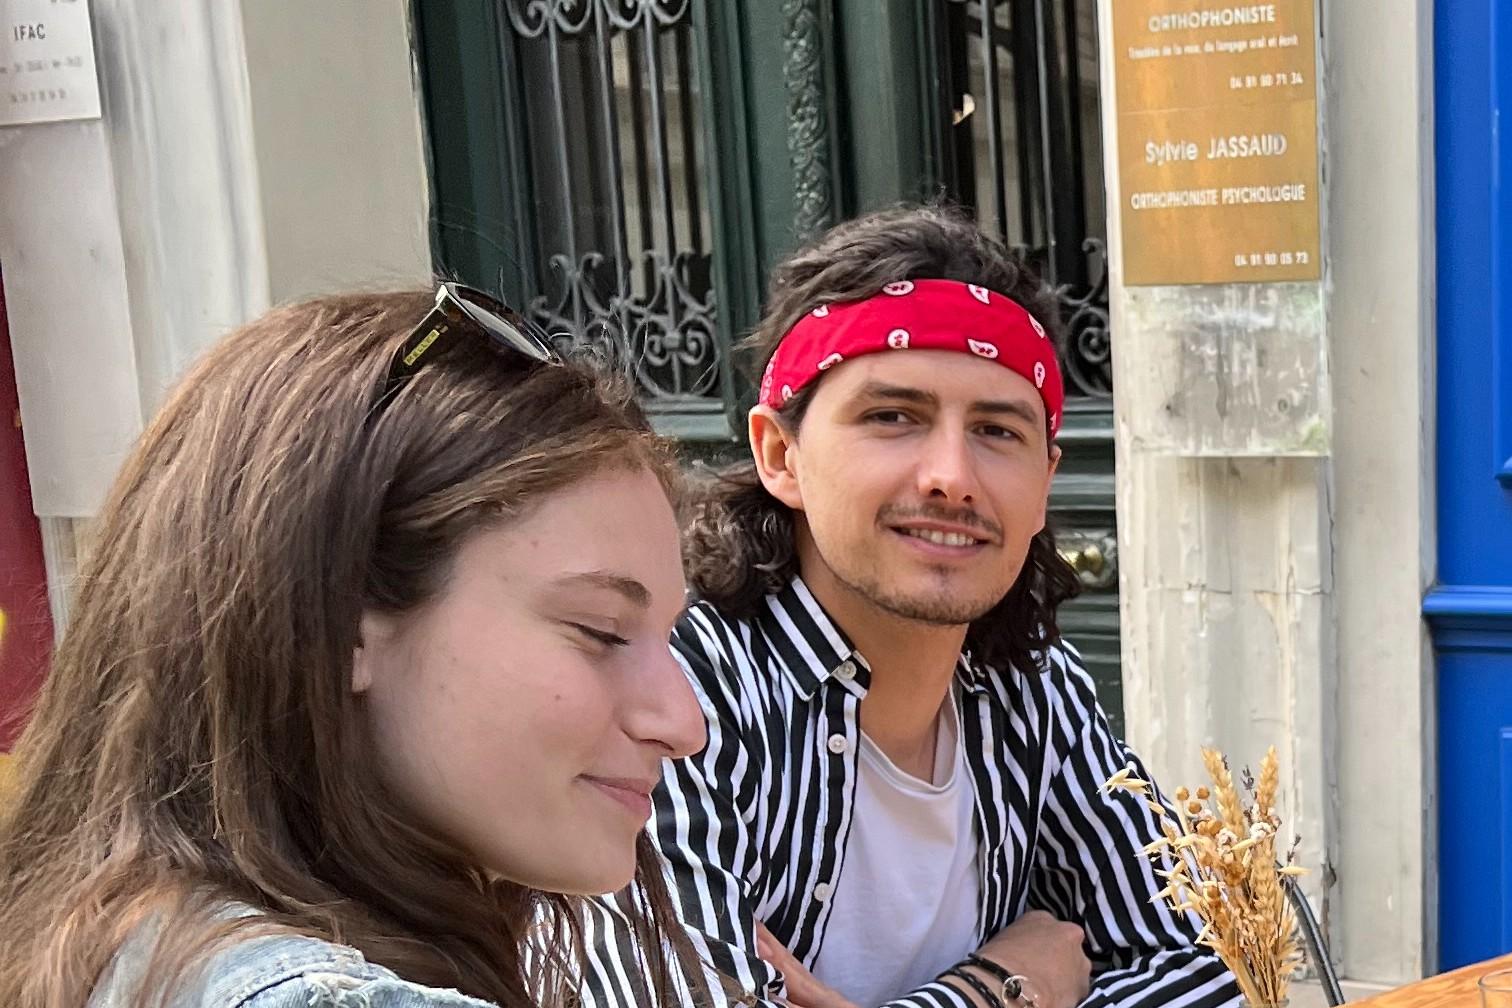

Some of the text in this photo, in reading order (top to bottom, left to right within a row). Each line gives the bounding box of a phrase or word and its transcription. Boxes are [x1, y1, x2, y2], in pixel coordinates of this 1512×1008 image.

[1148, 5, 1276, 32] ORTHOPHONISTE
[14, 23, 46, 41] IFAC
[1145, 134, 1288, 166] Sylvie JASSAUD
[1131, 184, 1306, 210] ORTHOPHONISTE PSYCHOLOGUE
